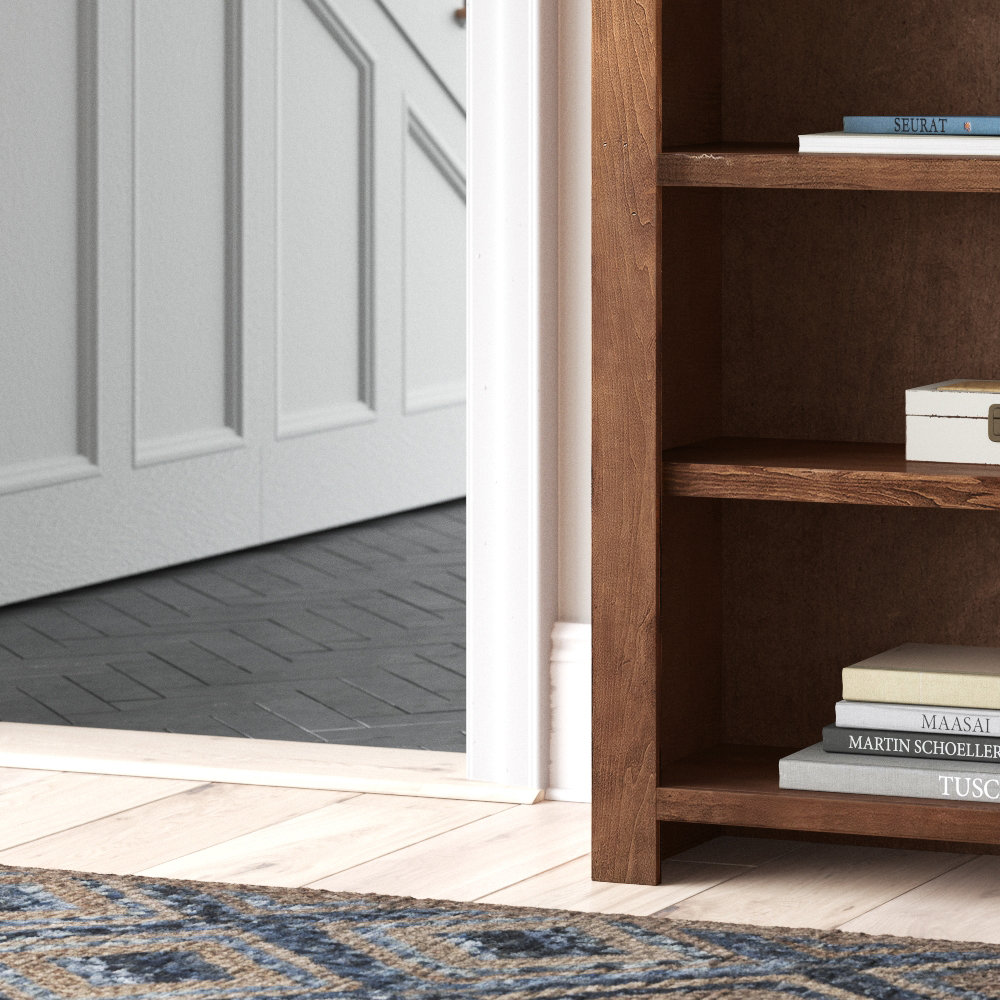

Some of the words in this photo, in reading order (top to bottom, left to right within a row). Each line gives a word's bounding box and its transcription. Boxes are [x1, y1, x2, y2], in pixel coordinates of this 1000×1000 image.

[894, 117, 948, 133] SEURAT
[921, 714, 991, 734] MAASAI
[848, 735, 911, 753] MARTIN
